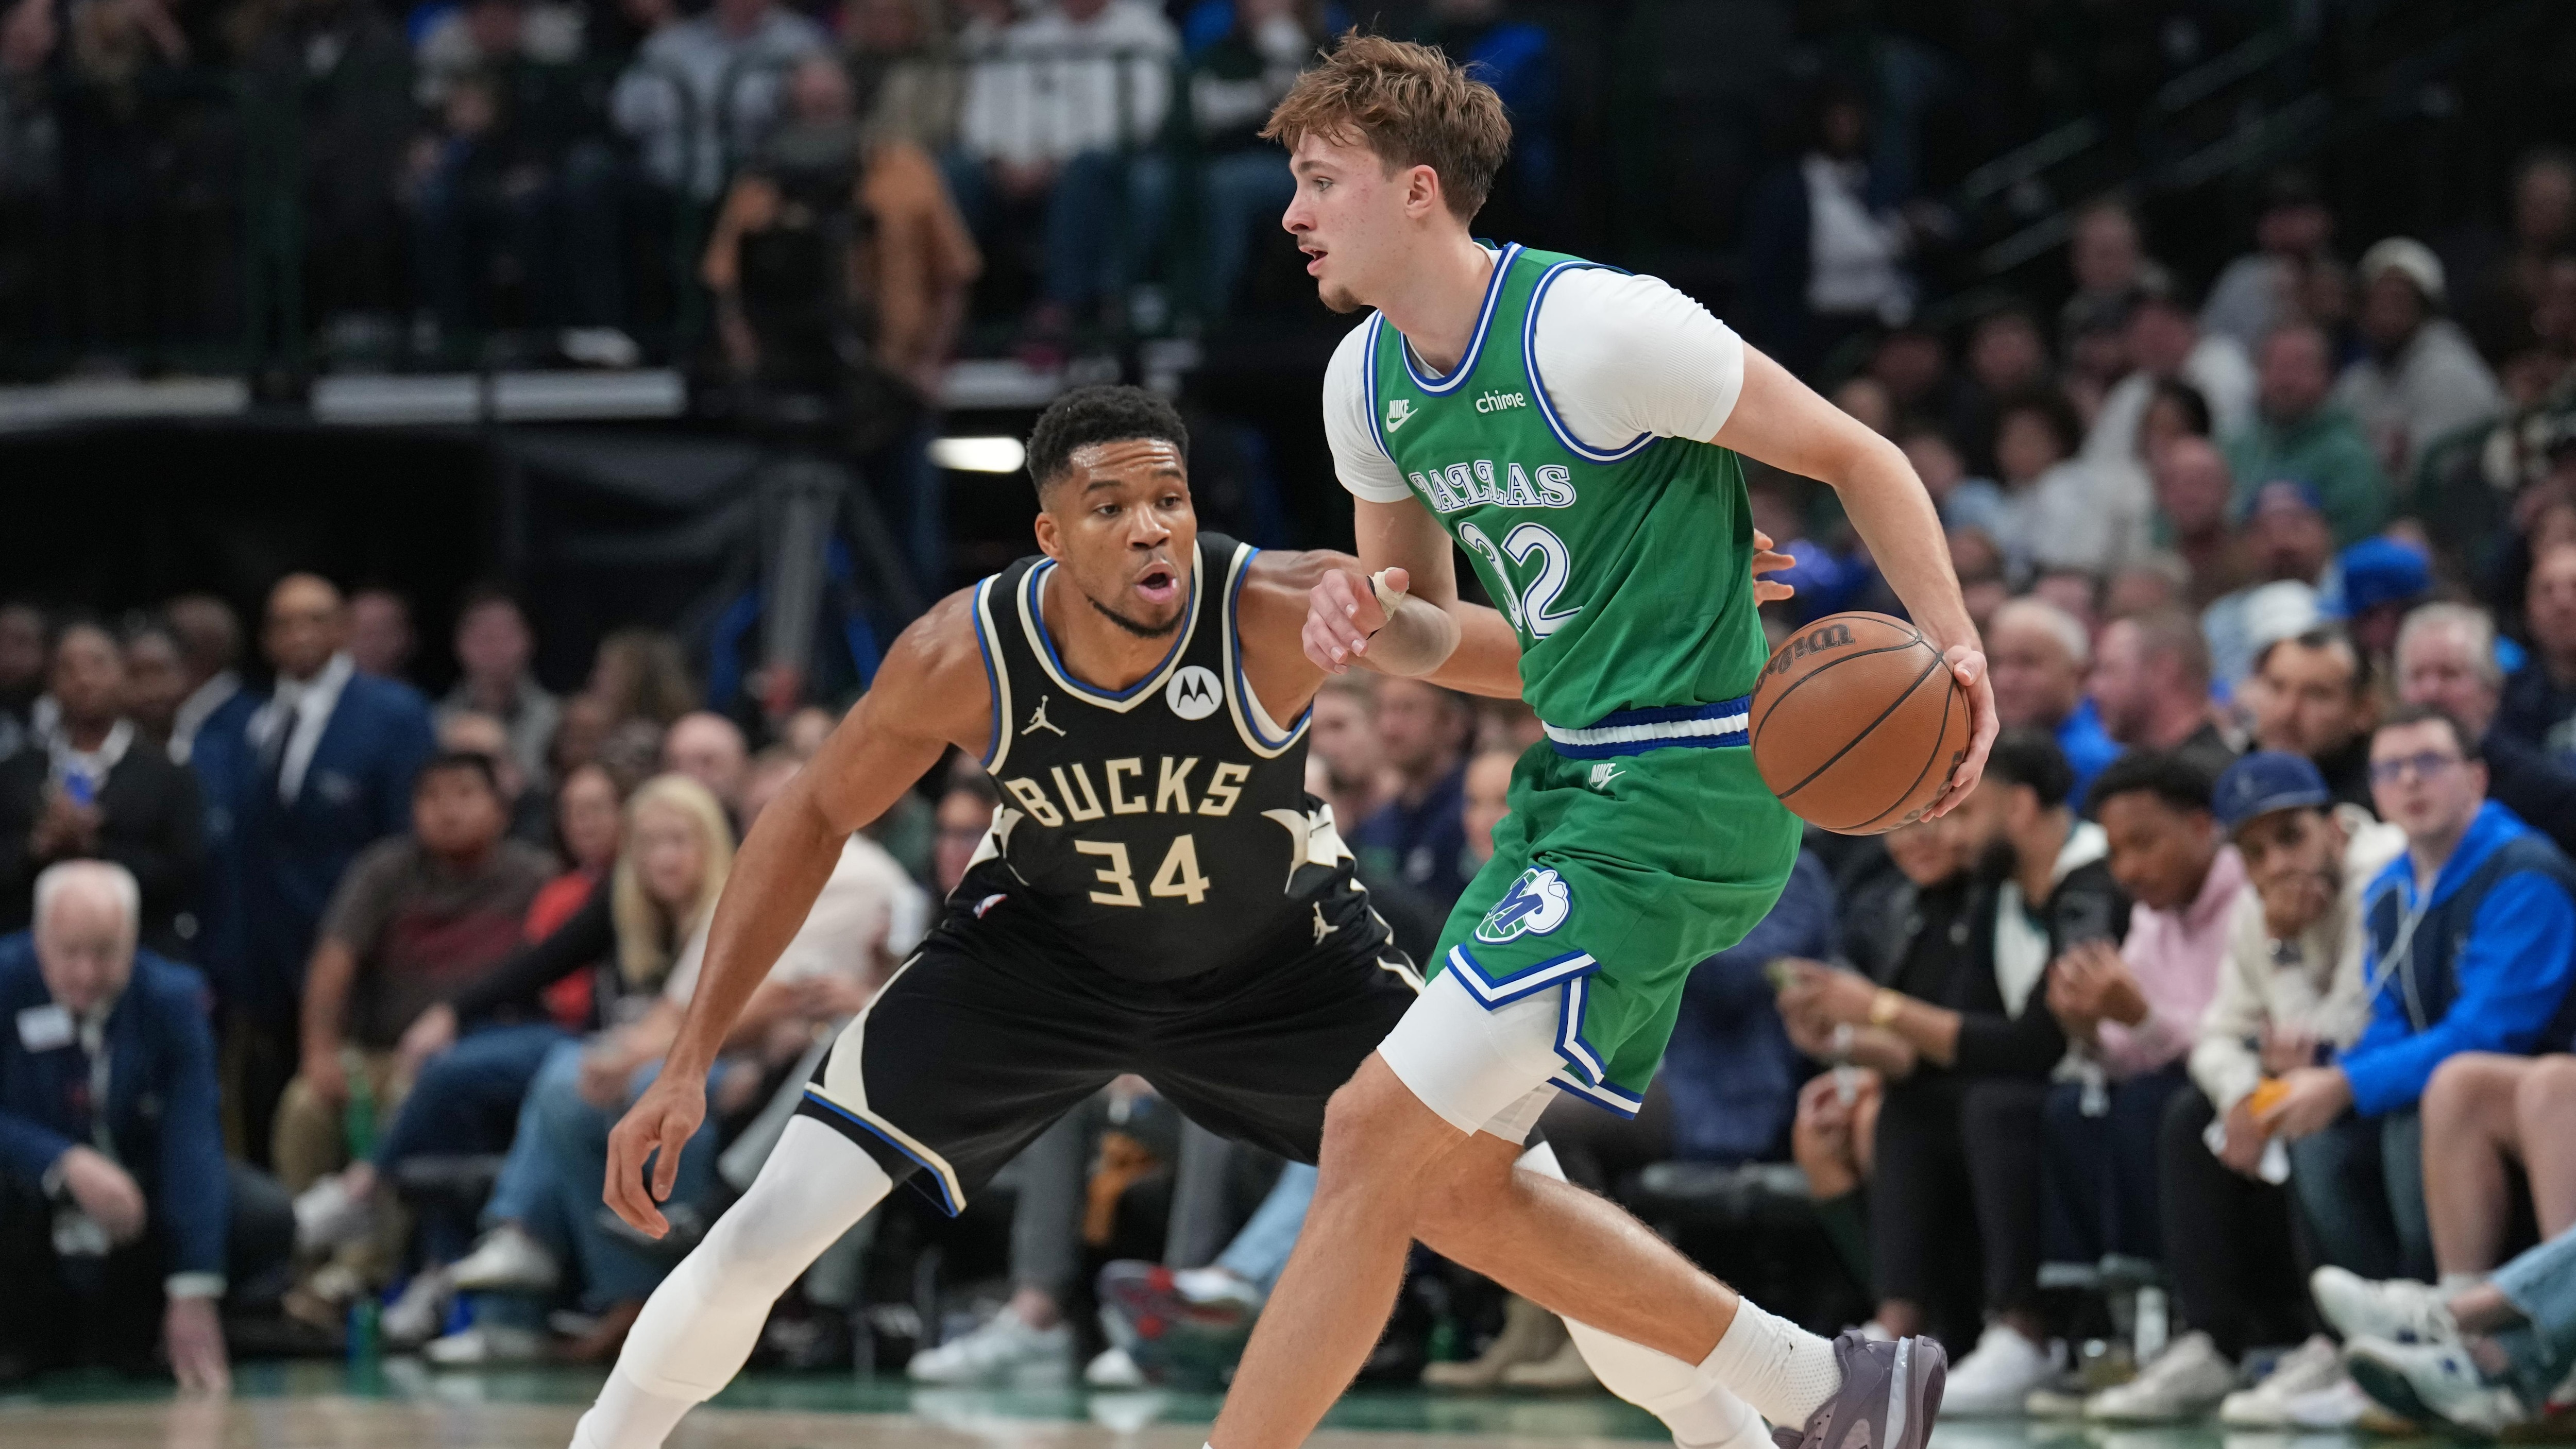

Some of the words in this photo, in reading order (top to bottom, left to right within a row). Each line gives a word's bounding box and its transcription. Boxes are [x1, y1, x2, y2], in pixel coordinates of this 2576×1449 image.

[1388, 399, 1411, 419] NIKE
[1476, 389, 1526, 414] chime
[1409, 459, 1577, 513] DALLAS
[1458, 521, 1584, 639] 32
[1005, 756, 1251, 827] BUCKS
[1590, 763, 1617, 783] NIKE
[1074, 833, 1210, 907] 34
